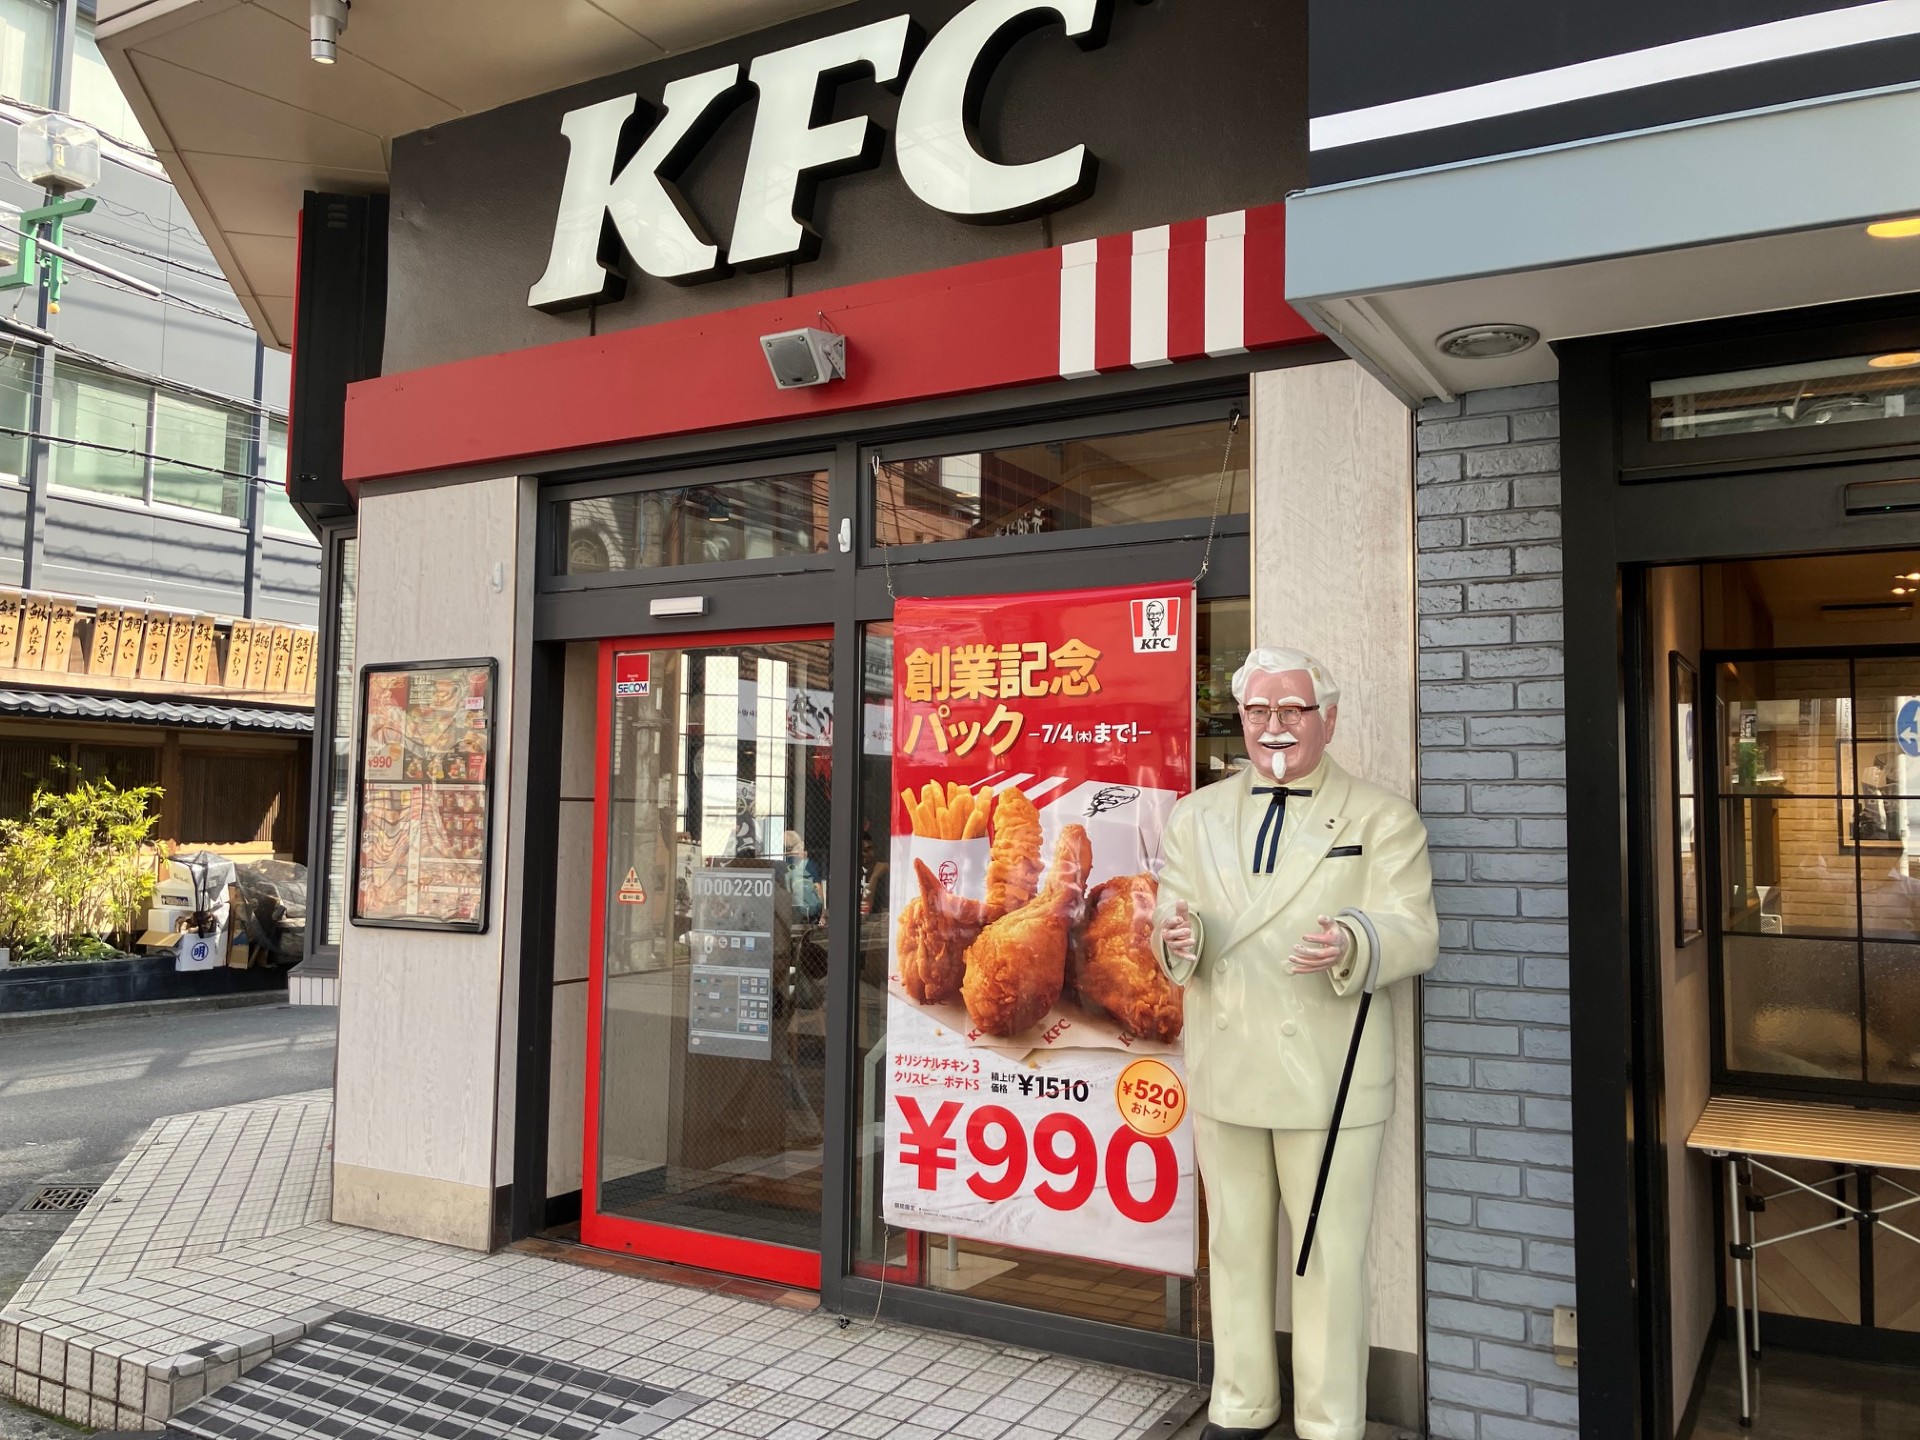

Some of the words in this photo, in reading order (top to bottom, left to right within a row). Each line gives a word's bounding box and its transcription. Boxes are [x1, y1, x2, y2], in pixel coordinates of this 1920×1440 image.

[528, 0, 1096, 308] KFC
[1140, 637, 1171, 650] KFC
[903, 638, 1102, 703] 創業記念
[618, 683, 648, 693] SECOM
[903, 703, 1025, 757] パック
[194, 945, 206, 958] 明
[1042, 1018, 1072, 1044] KFC
[894, 1054, 970, 1073] オリジナルチキン
[972, 1059, 981, 1074] 3
[894, 1070, 938, 1086] クリスピー
[991, 1083, 1008, 1094] 価格
[1018, 1074, 1089, 1102] ¥1510
[1122, 1078, 1179, 1109] ¥520
[894, 1095, 1179, 1223] ¥990
